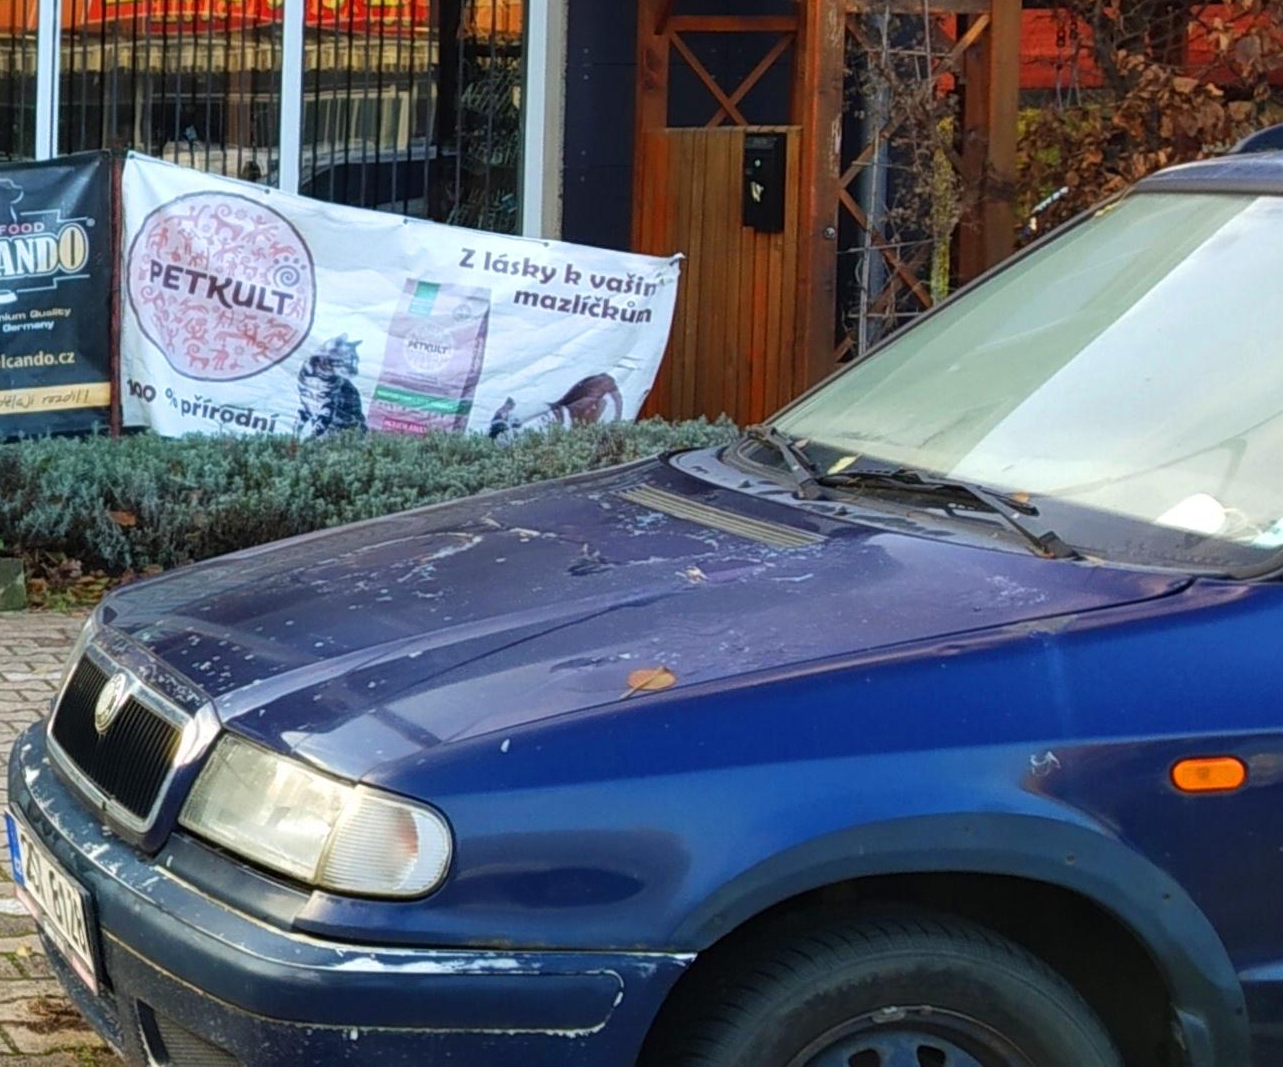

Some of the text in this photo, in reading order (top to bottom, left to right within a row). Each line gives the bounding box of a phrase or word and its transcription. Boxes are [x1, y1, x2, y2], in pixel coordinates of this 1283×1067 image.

[459, 248, 476, 269] Z
[484, 251, 556, 284] lásky
[564, 263, 582, 285] k
[150, 259, 294, 316] PETKULT
[30, 308, 72, 318] Quality
[2, 320, 55, 333] Germany
[408, 340, 448, 354] PETKULT
[127, 378, 156, 402] 100
[181, 394, 280, 432] přírodní
